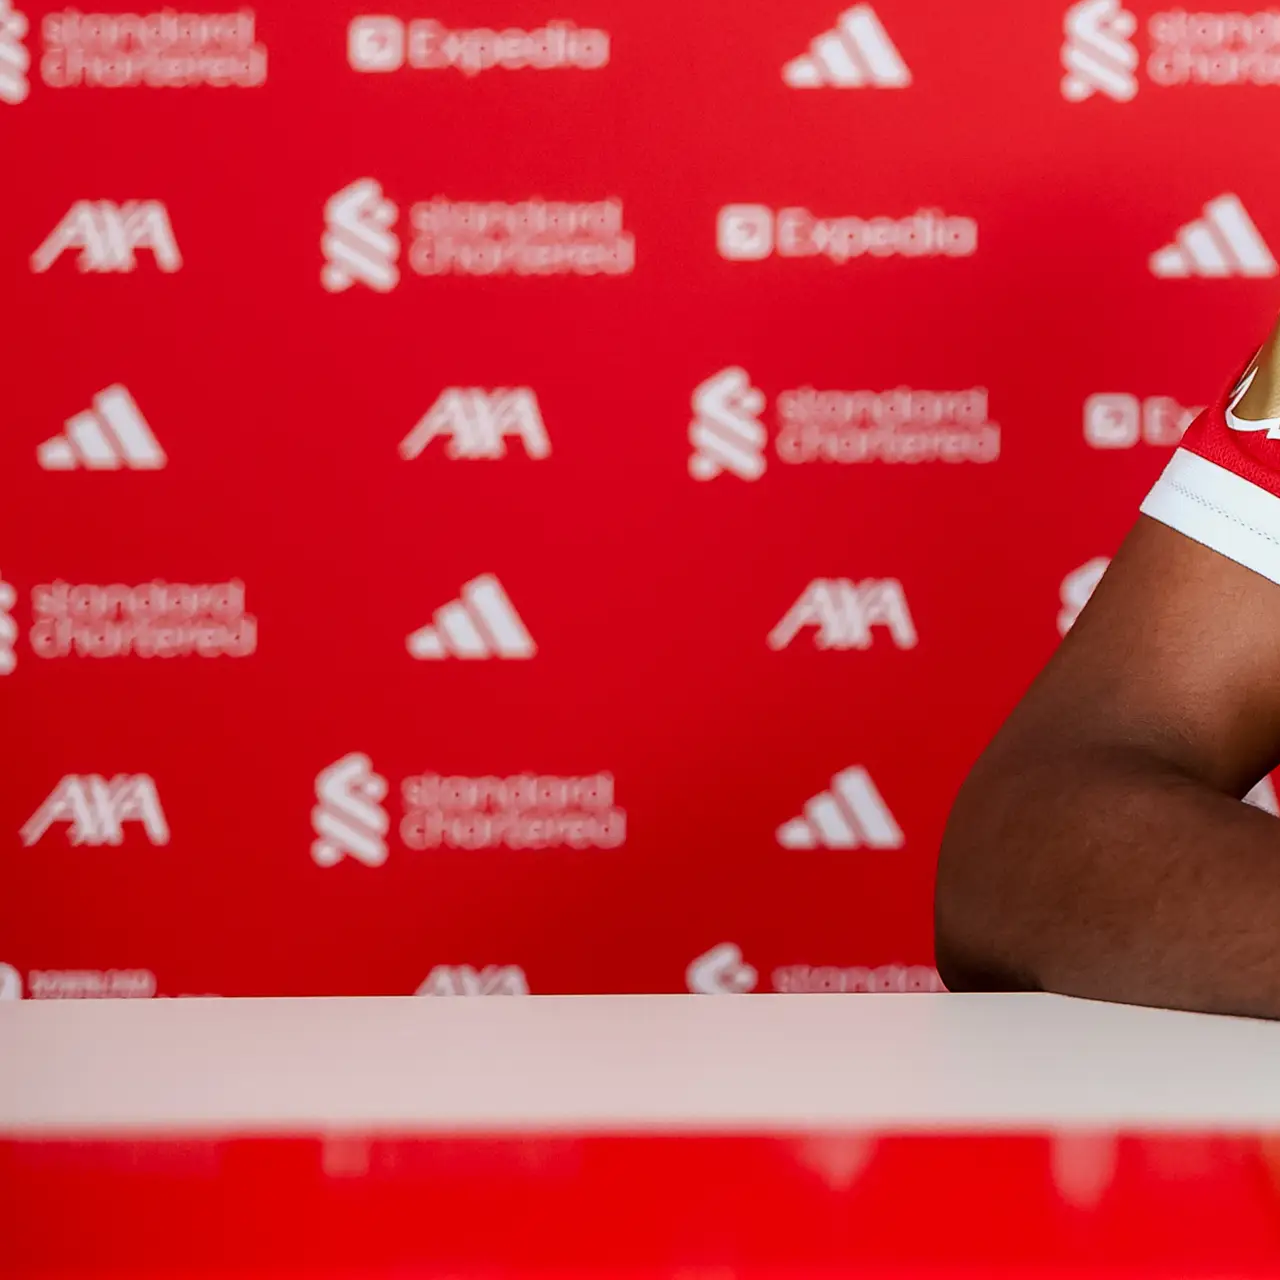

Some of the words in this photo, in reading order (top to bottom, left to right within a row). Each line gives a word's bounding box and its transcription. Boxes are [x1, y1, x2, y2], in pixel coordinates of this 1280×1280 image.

[41, 10, 256, 49] standard
[407, 18, 610, 77] Expedia
[40, 47, 268, 88] chartered
[33, 200, 181, 272] AXA
[409, 197, 623, 237] standard
[775, 206, 978, 265] Expedia
[408, 235, 636, 276] chartered
[401, 388, 550, 459] AXA
[776, 386, 988, 426] standard
[775, 424, 1001, 464] chartered
[31, 580, 245, 620] standard
[769, 579, 916, 649] AXA
[29, 618, 257, 658] chartered
[22, 774, 168, 845] AXA
[401, 772, 614, 812] standard
[399, 810, 627, 850] chartered
